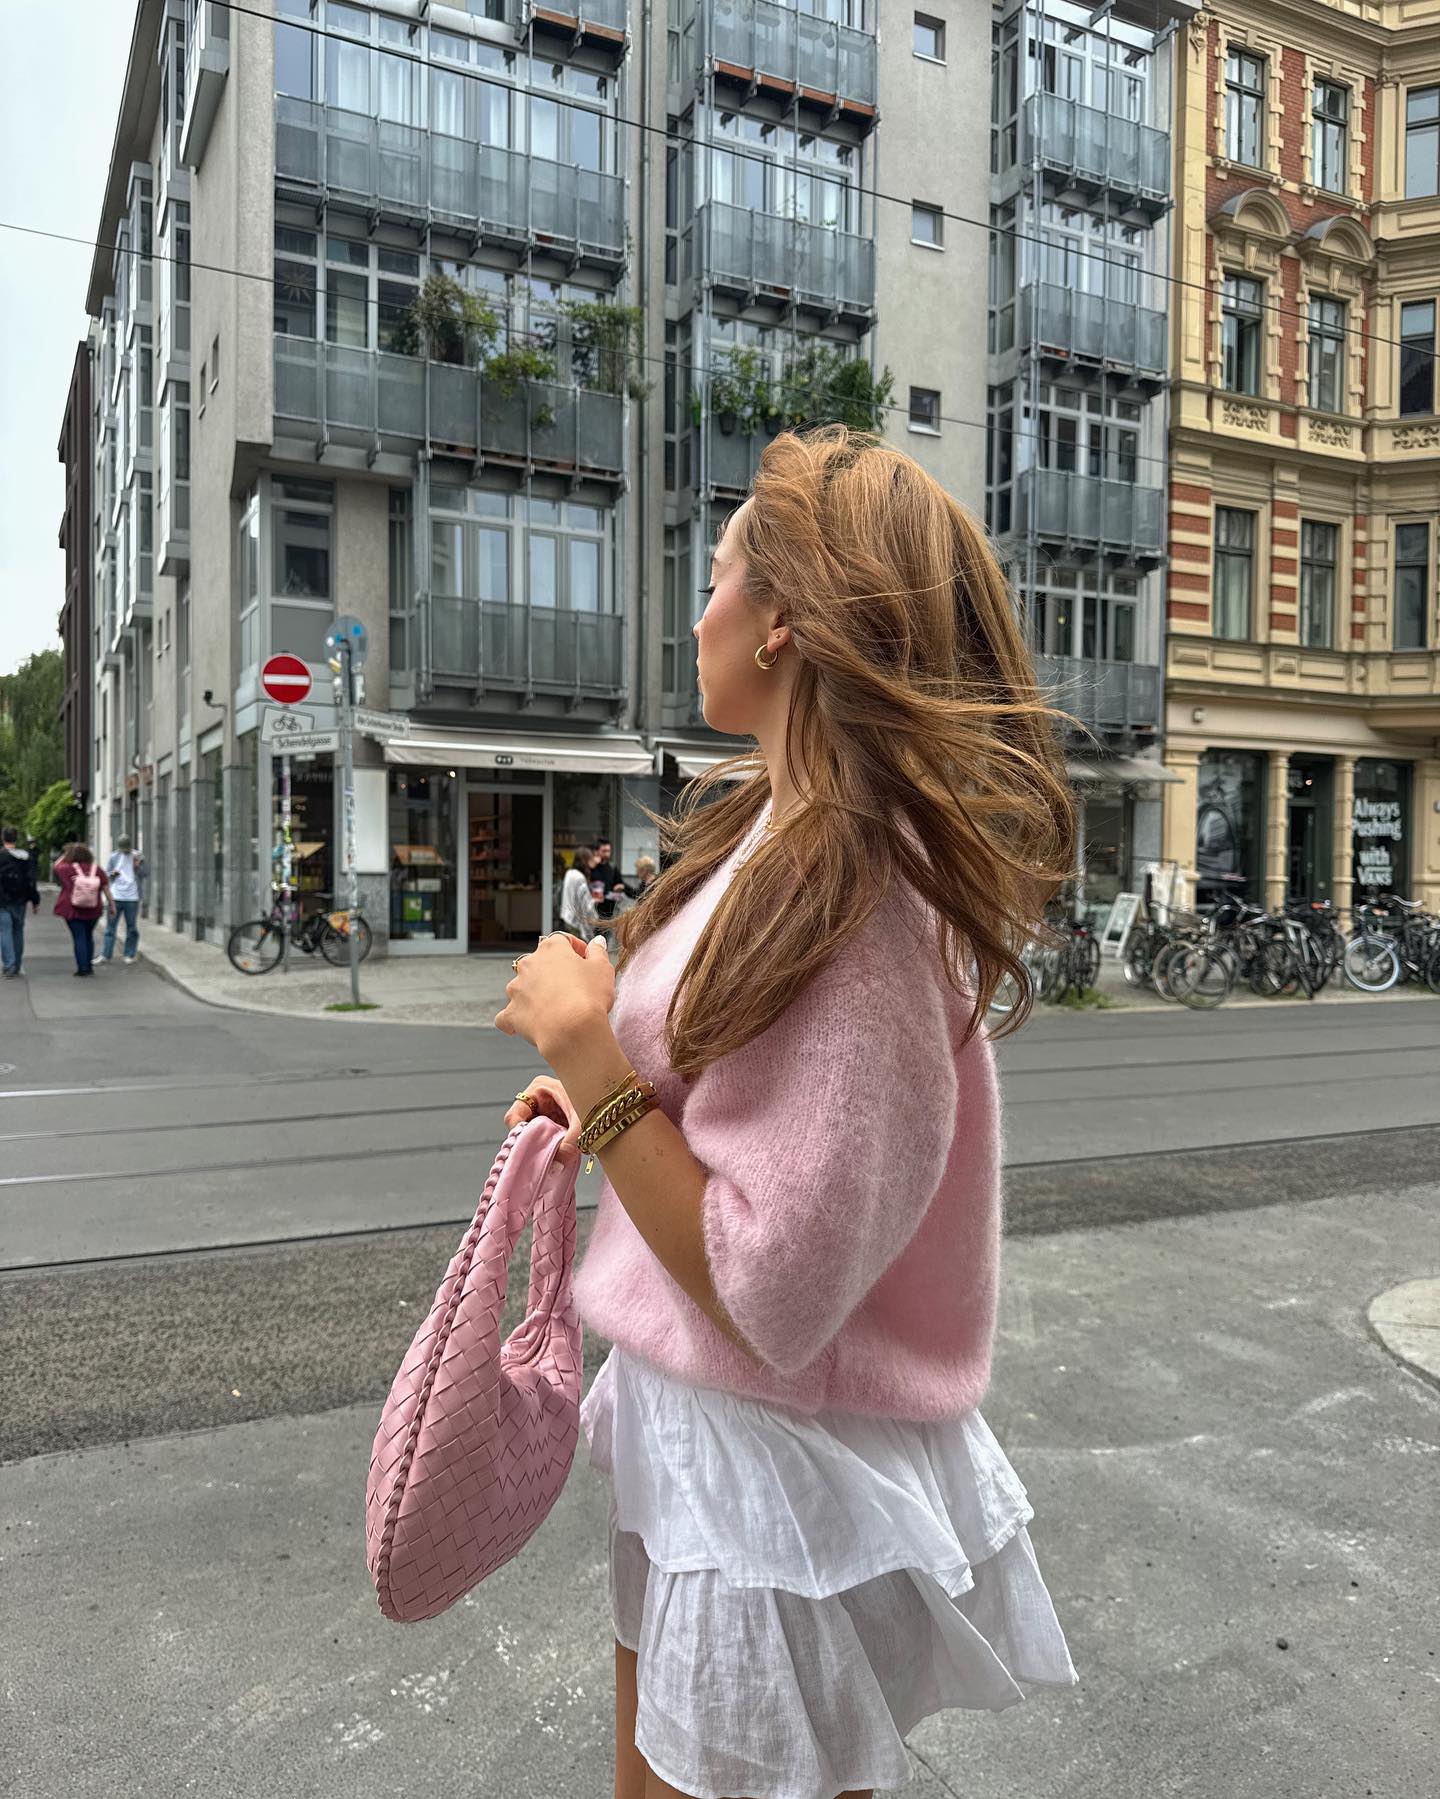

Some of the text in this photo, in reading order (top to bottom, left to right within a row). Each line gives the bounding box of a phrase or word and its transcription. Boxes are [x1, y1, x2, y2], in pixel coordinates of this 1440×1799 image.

[278, 735, 332, 748] Schendelgasse
[1355, 797, 1400, 820] Always
[1359, 846, 1390, 866] with
[1356, 866, 1392, 886] VANS
